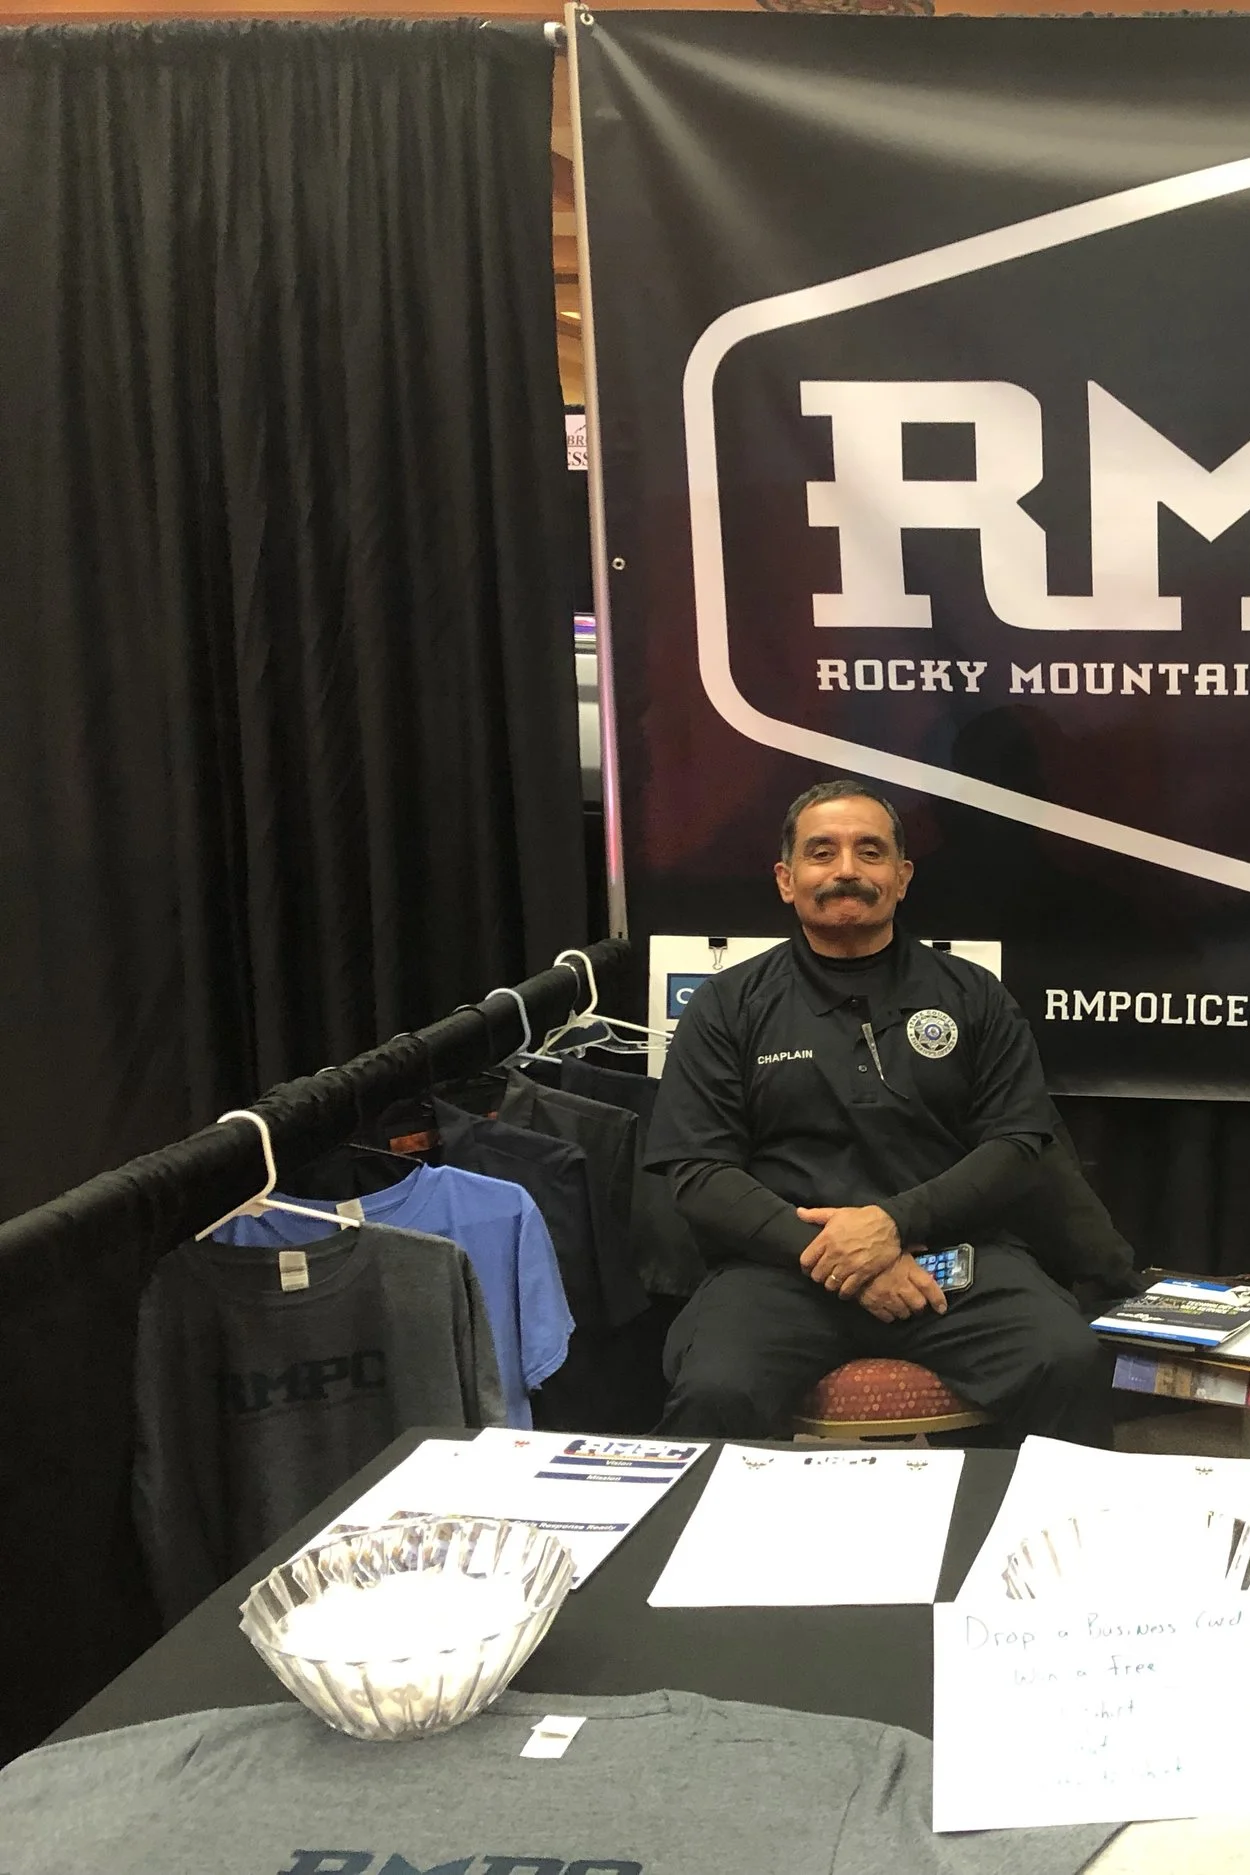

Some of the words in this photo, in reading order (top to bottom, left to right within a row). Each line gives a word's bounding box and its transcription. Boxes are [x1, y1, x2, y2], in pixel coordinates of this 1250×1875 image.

[816, 658, 988, 693] ROCKY
[757, 1049, 813, 1065] CHAPLAIN
[605, 1459, 633, 1467] Vision
[586, 1474, 621, 1482] Mission
[539, 1521, 585, 1531] Response
[586, 1523, 617, 1532] Ready
[965, 1614, 1036, 1650] Drop
